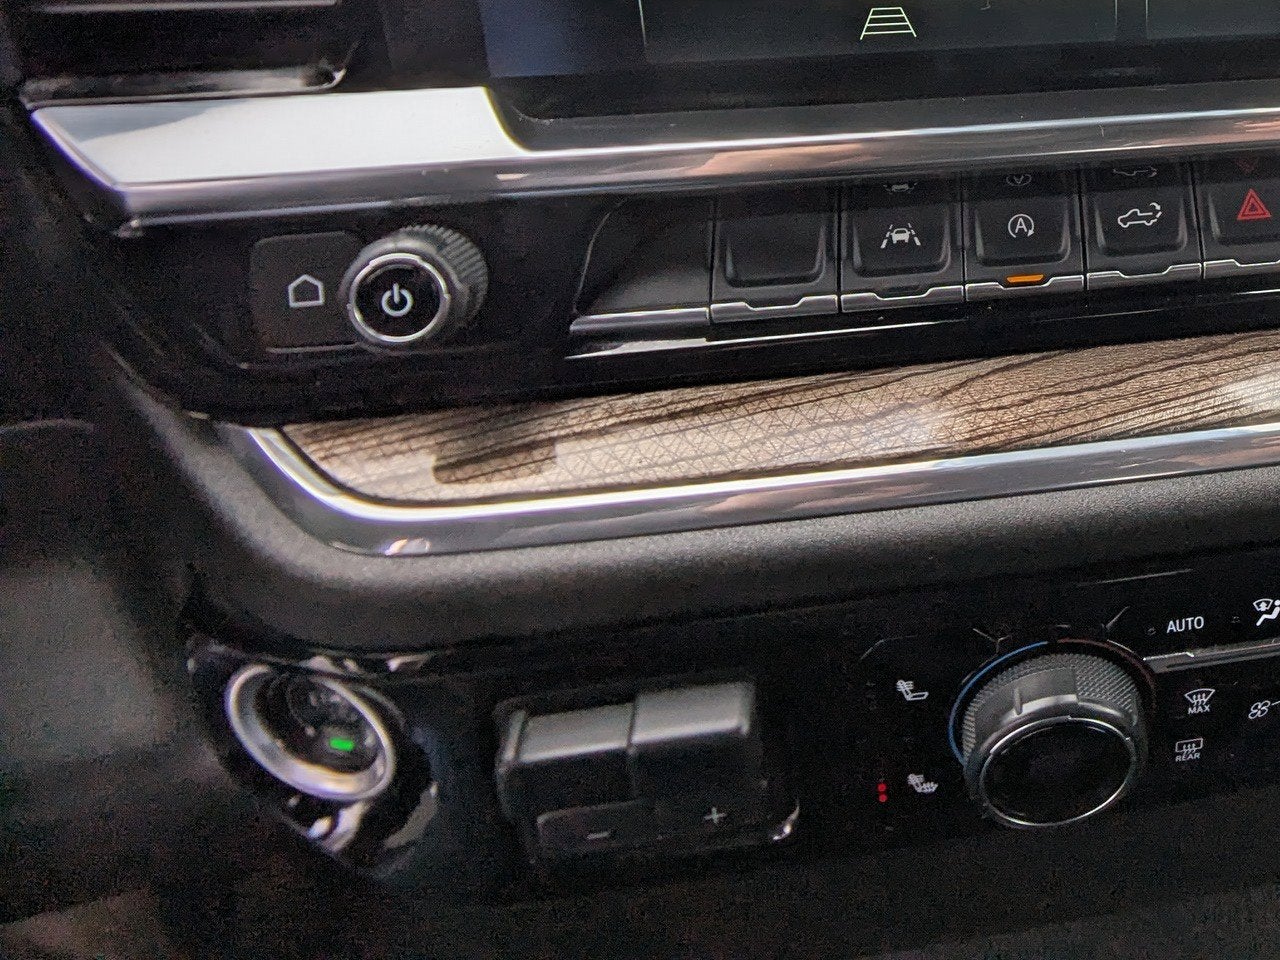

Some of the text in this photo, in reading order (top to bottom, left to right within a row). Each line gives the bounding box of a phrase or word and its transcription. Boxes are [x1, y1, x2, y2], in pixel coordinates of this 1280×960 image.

[1166, 616, 1205, 634] AUTO
[1187, 704, 1211, 715] MAX
[1175, 752, 1200, 762] REAR
